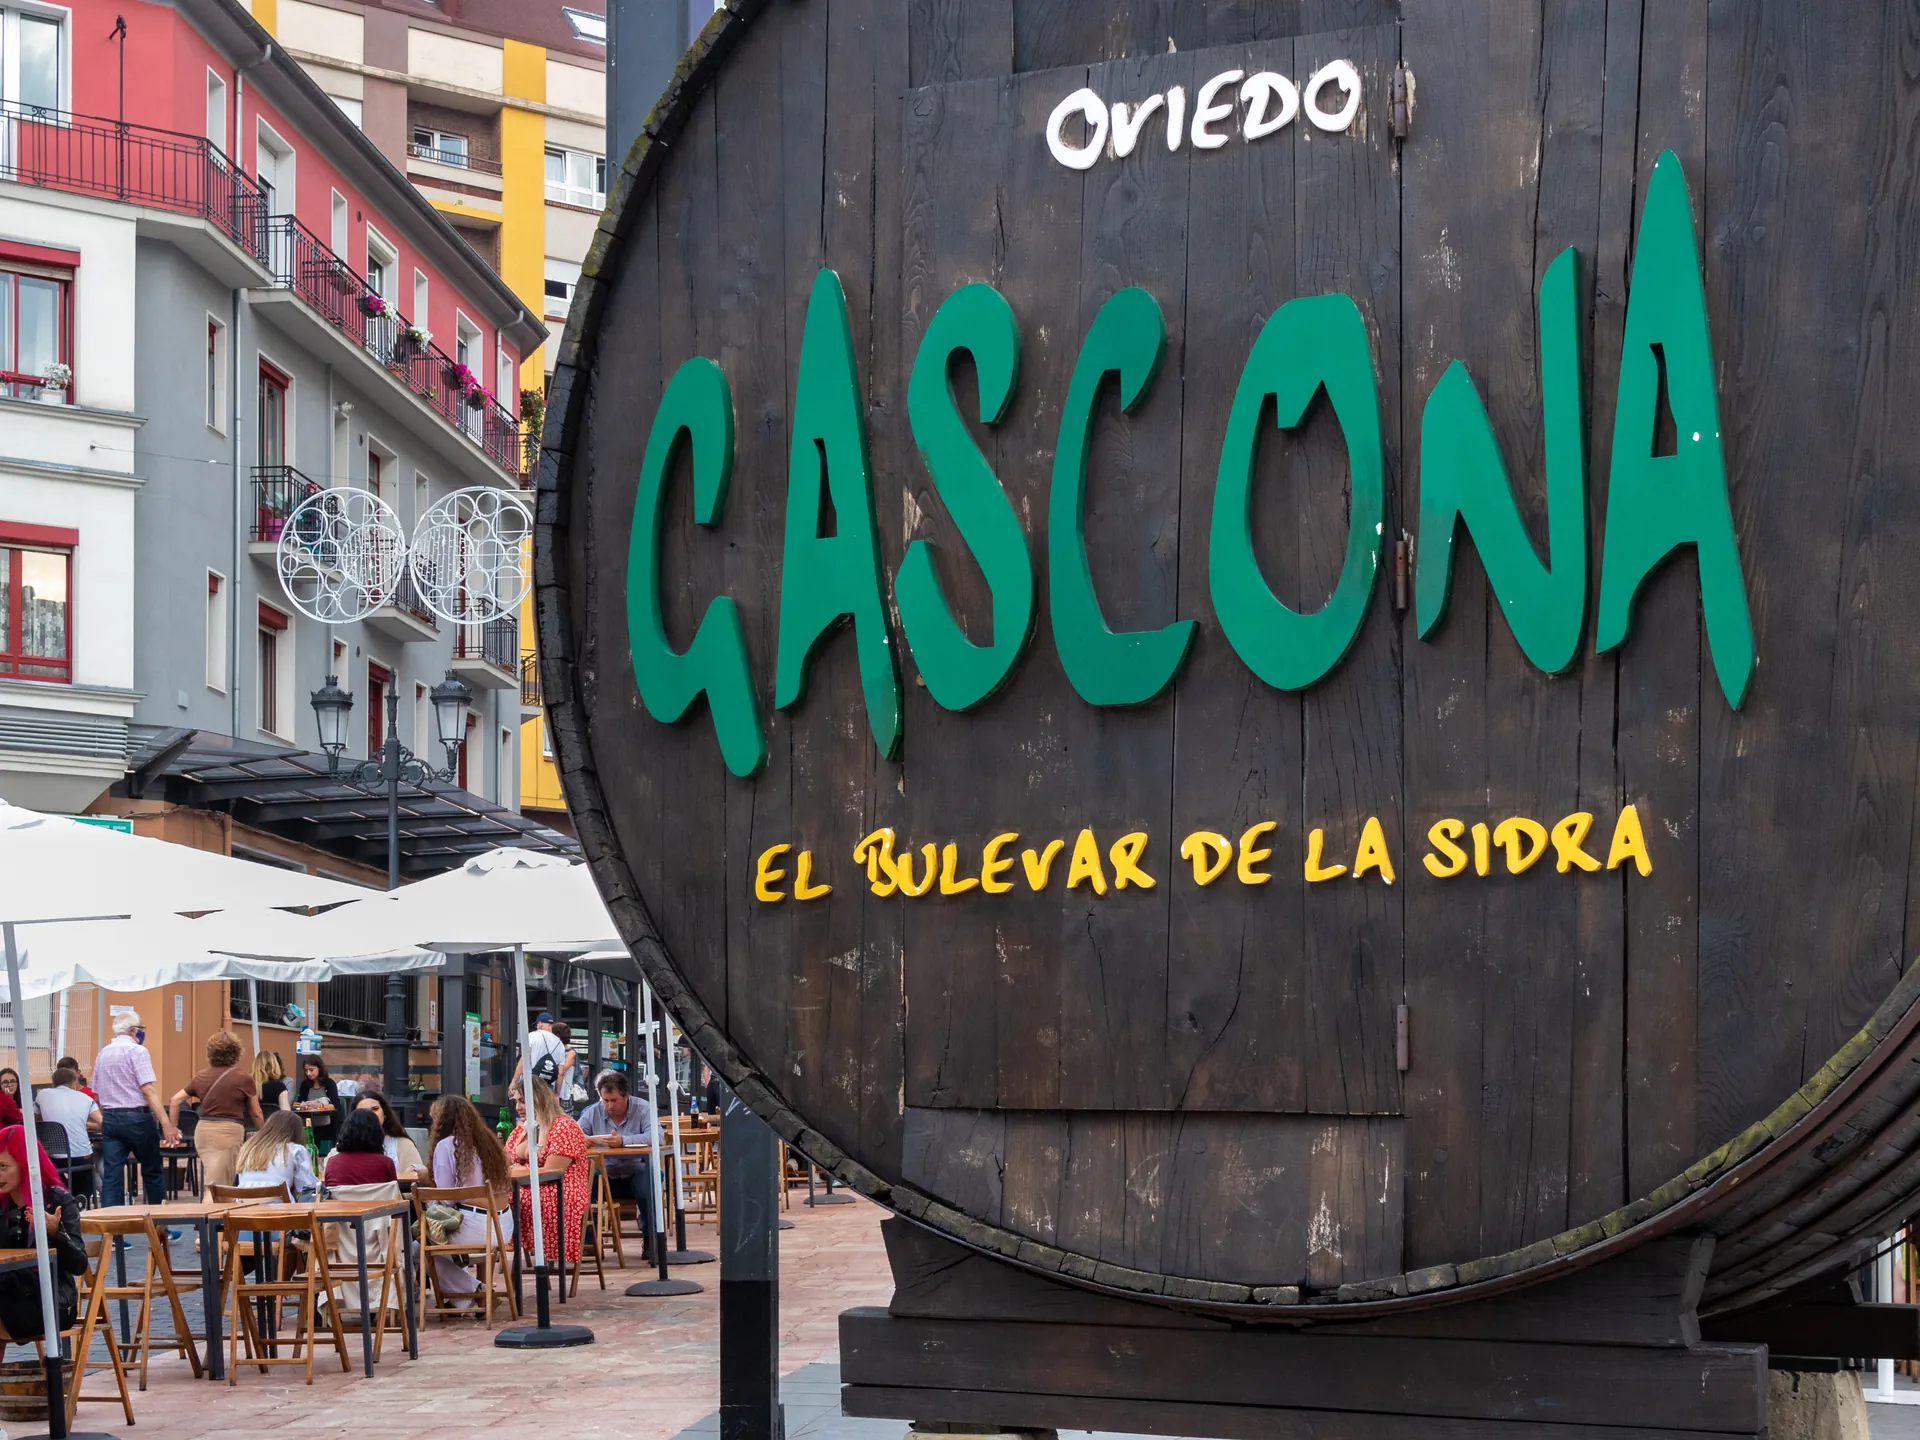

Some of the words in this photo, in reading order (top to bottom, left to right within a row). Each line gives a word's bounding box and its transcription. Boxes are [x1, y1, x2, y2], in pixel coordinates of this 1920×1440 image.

[1045, 58, 1363, 170] OVIEDO
[626, 148, 1758, 778] GASCONA
[754, 842, 831, 903] EL
[852, 826, 1157, 897] BULEVAR
[1180, 820, 1278, 886] DE
[1304, 815, 1396, 885] LA
[1422, 804, 1653, 878] SIDRA
